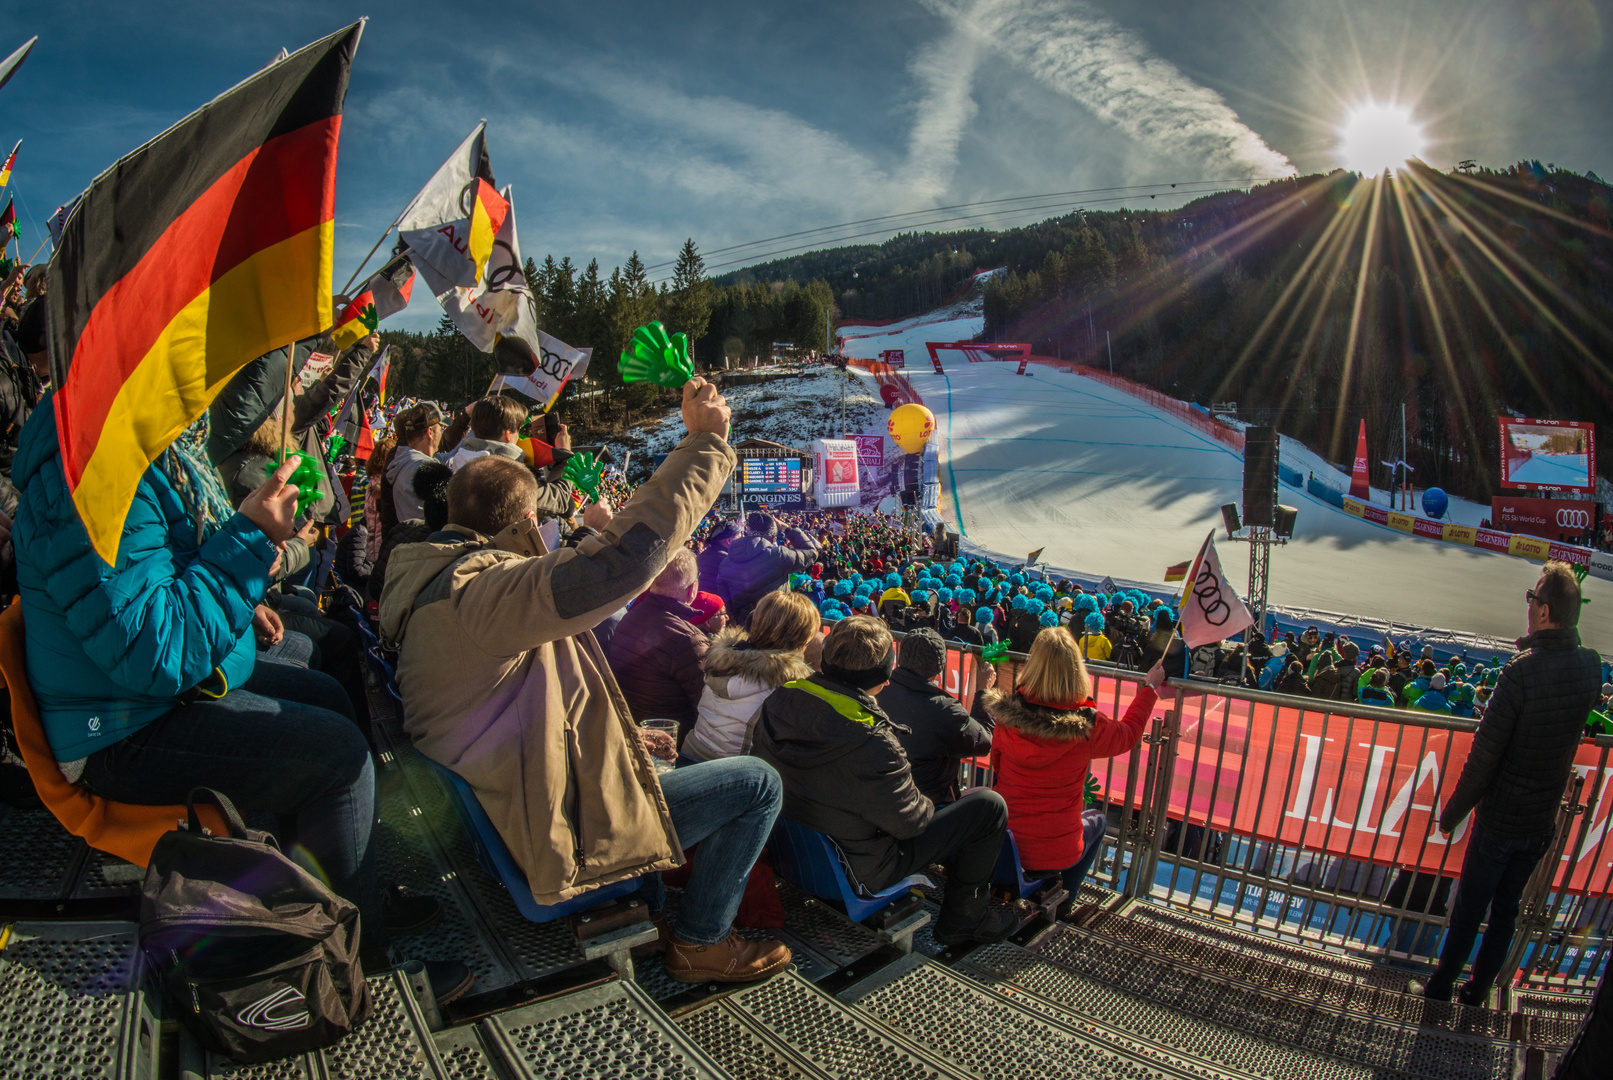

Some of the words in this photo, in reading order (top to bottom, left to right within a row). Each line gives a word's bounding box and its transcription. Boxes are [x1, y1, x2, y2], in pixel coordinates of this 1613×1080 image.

[437, 224, 476, 263] Au
[467, 287, 496, 324] udi
[743, 494, 801, 502] LONGINES
[1396, 517, 1409, 526] LOTTO
[1420, 524, 1443, 535] GENERALI
[1454, 530, 1470, 539] LOTTO
[1484, 534, 1510, 547] GENERALI
[1522, 542, 1542, 554] LOTTO
[1558, 550, 1591, 566] GENERALI
